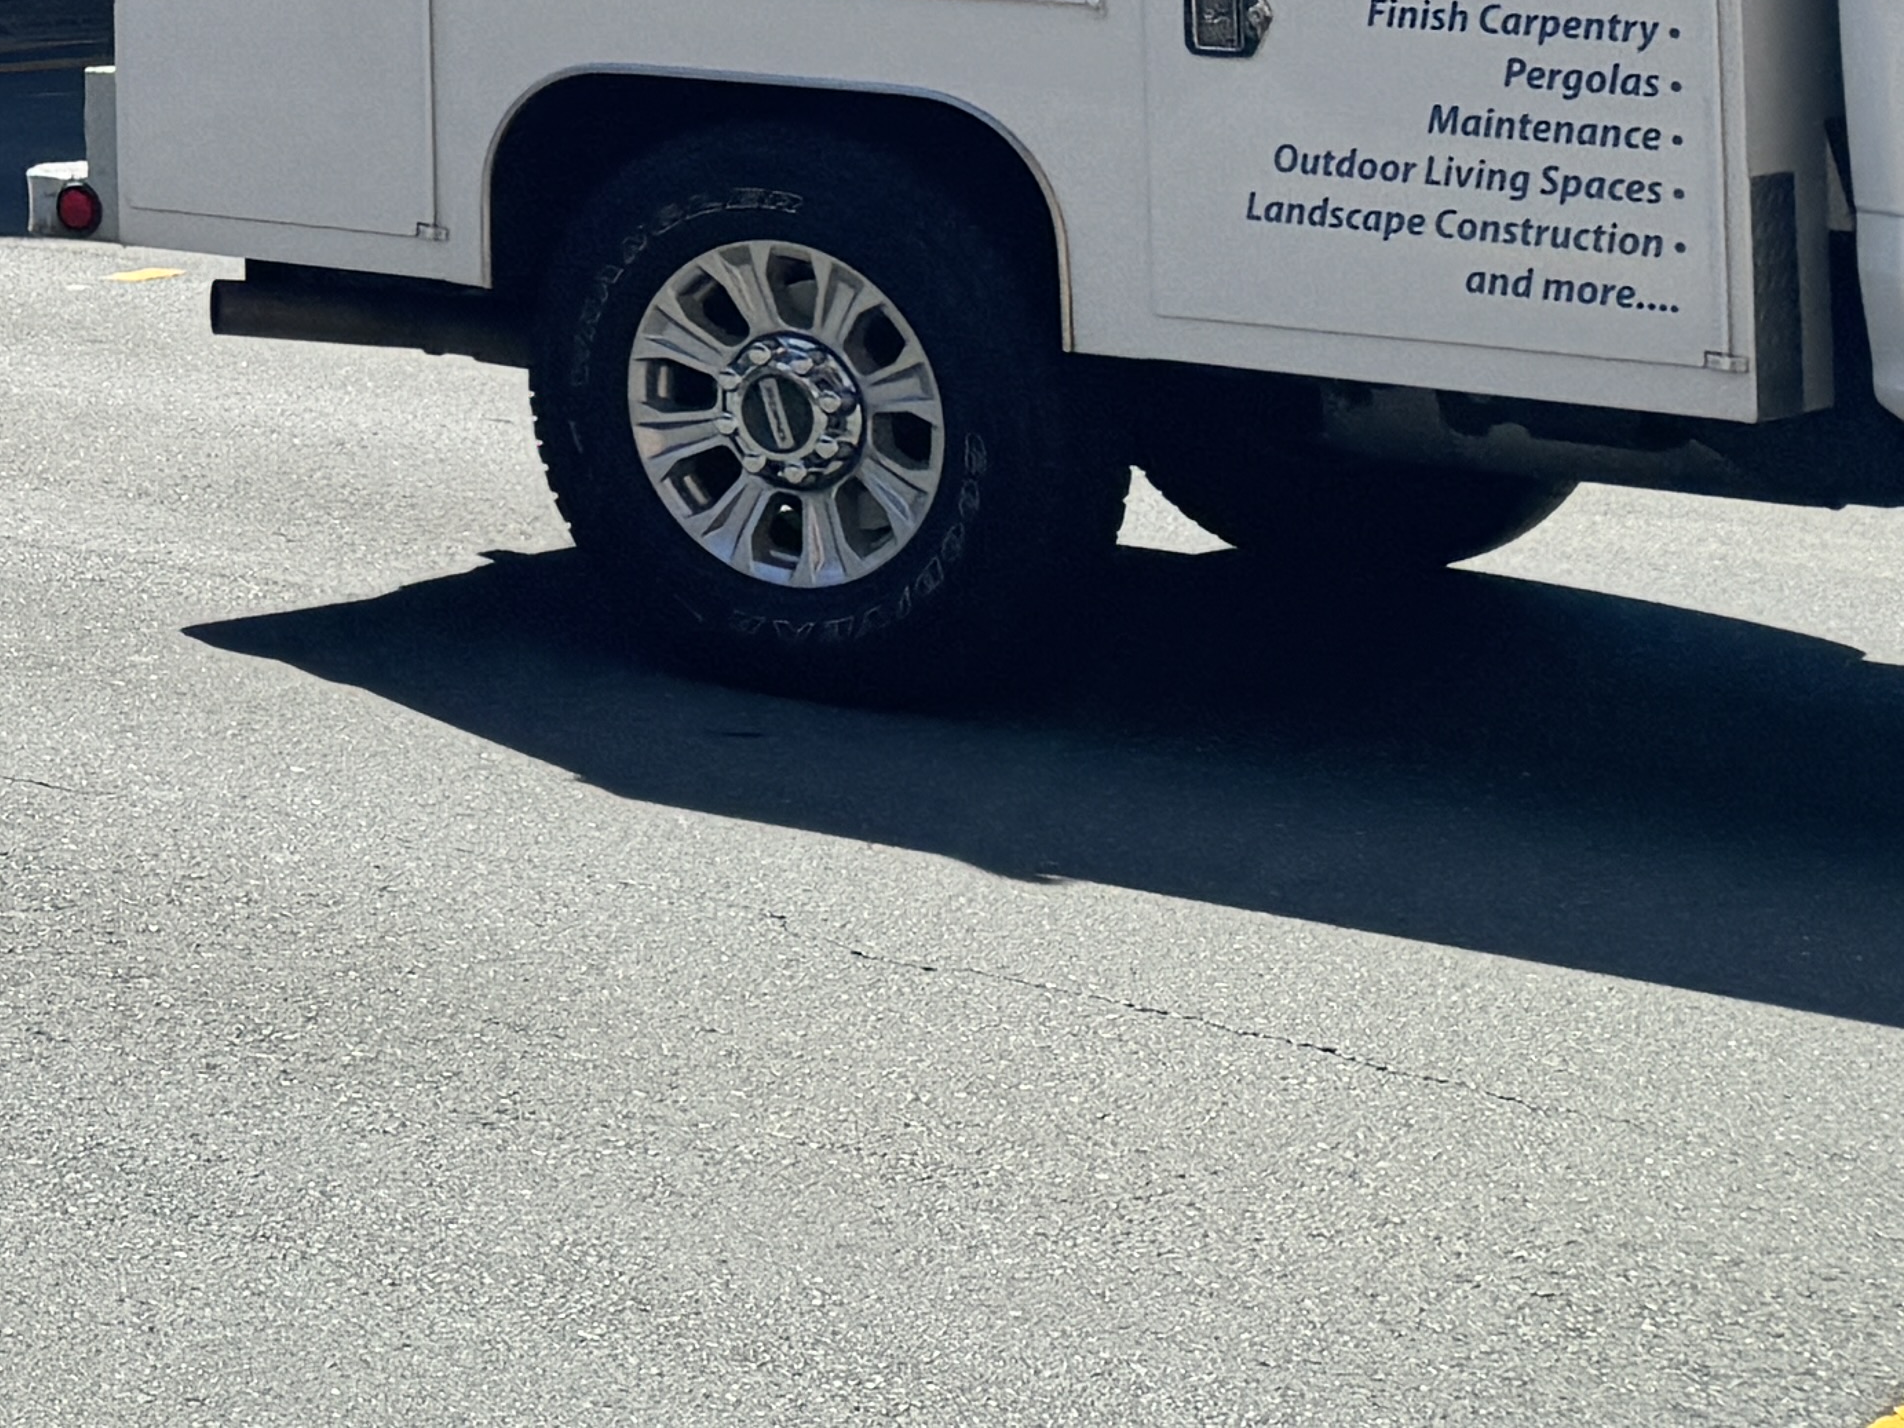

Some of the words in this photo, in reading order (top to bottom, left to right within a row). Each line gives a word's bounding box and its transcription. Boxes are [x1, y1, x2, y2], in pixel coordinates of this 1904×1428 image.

[1479, 4, 1659, 53] Carpentry
[1504, 57, 1659, 100] Pergolas
[1427, 104, 1661, 151] Maintenance
[1274, 144, 1418, 183] Outdoor
[1424, 155, 1530, 201] Living
[1539, 165, 1662, 205] Spaces
[1246, 191, 1426, 241] Landscape
[1435, 209, 1663, 258] Construction
[1466, 267, 1534, 299] and
